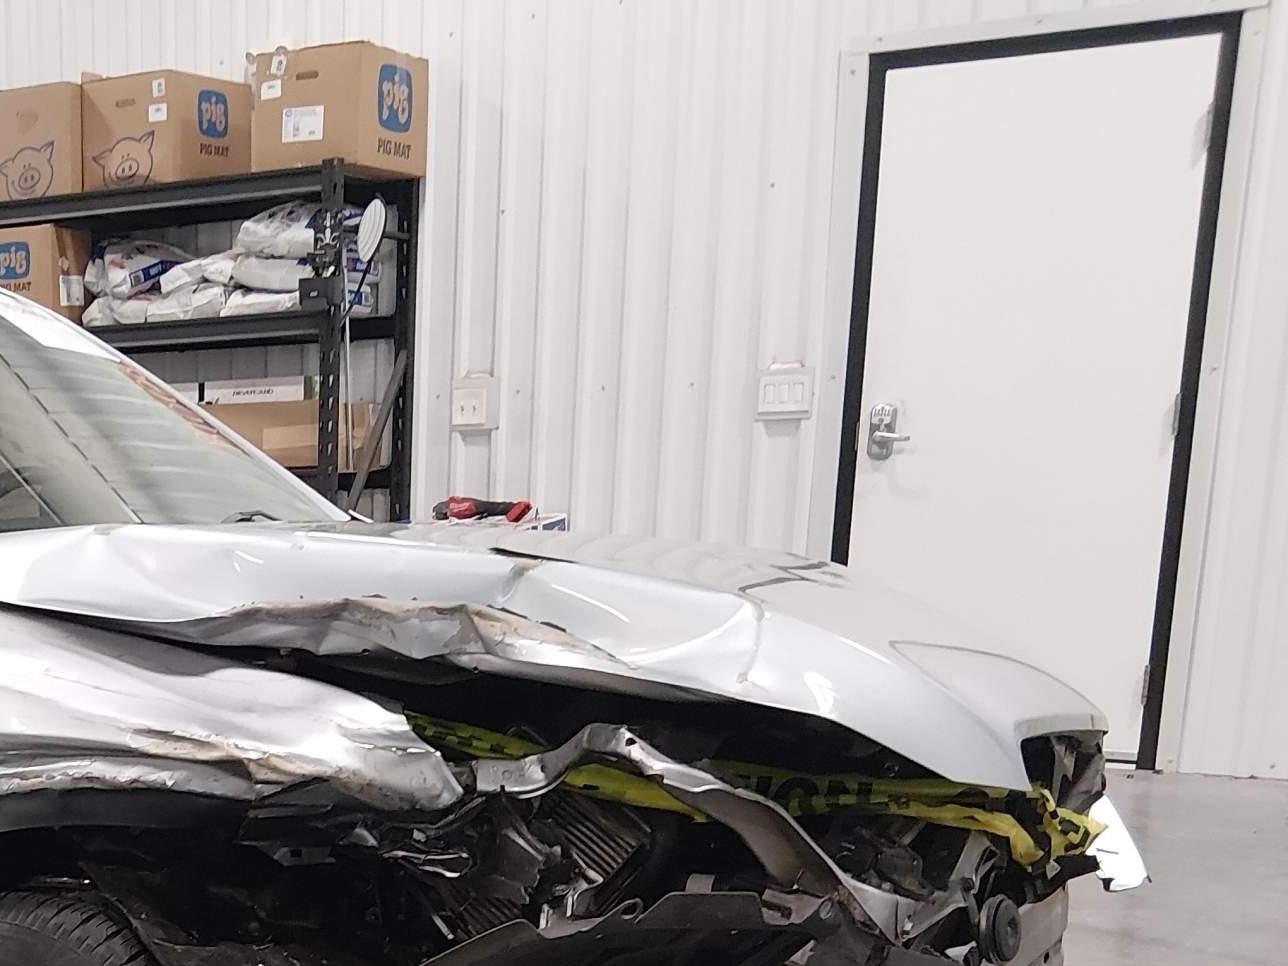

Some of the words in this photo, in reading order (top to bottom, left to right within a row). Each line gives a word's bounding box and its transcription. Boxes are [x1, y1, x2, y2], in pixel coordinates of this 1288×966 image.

[382, 73, 409, 124] pig
[201, 95, 225, 131] pig
[200, 143, 213, 156] PIG
[214, 145, 229, 157] MAT
[377, 139, 392, 156] PIG
[393, 142, 412, 160] MAT
[0, 246, 27, 276] pig
[13, 281, 32, 292] MAT
